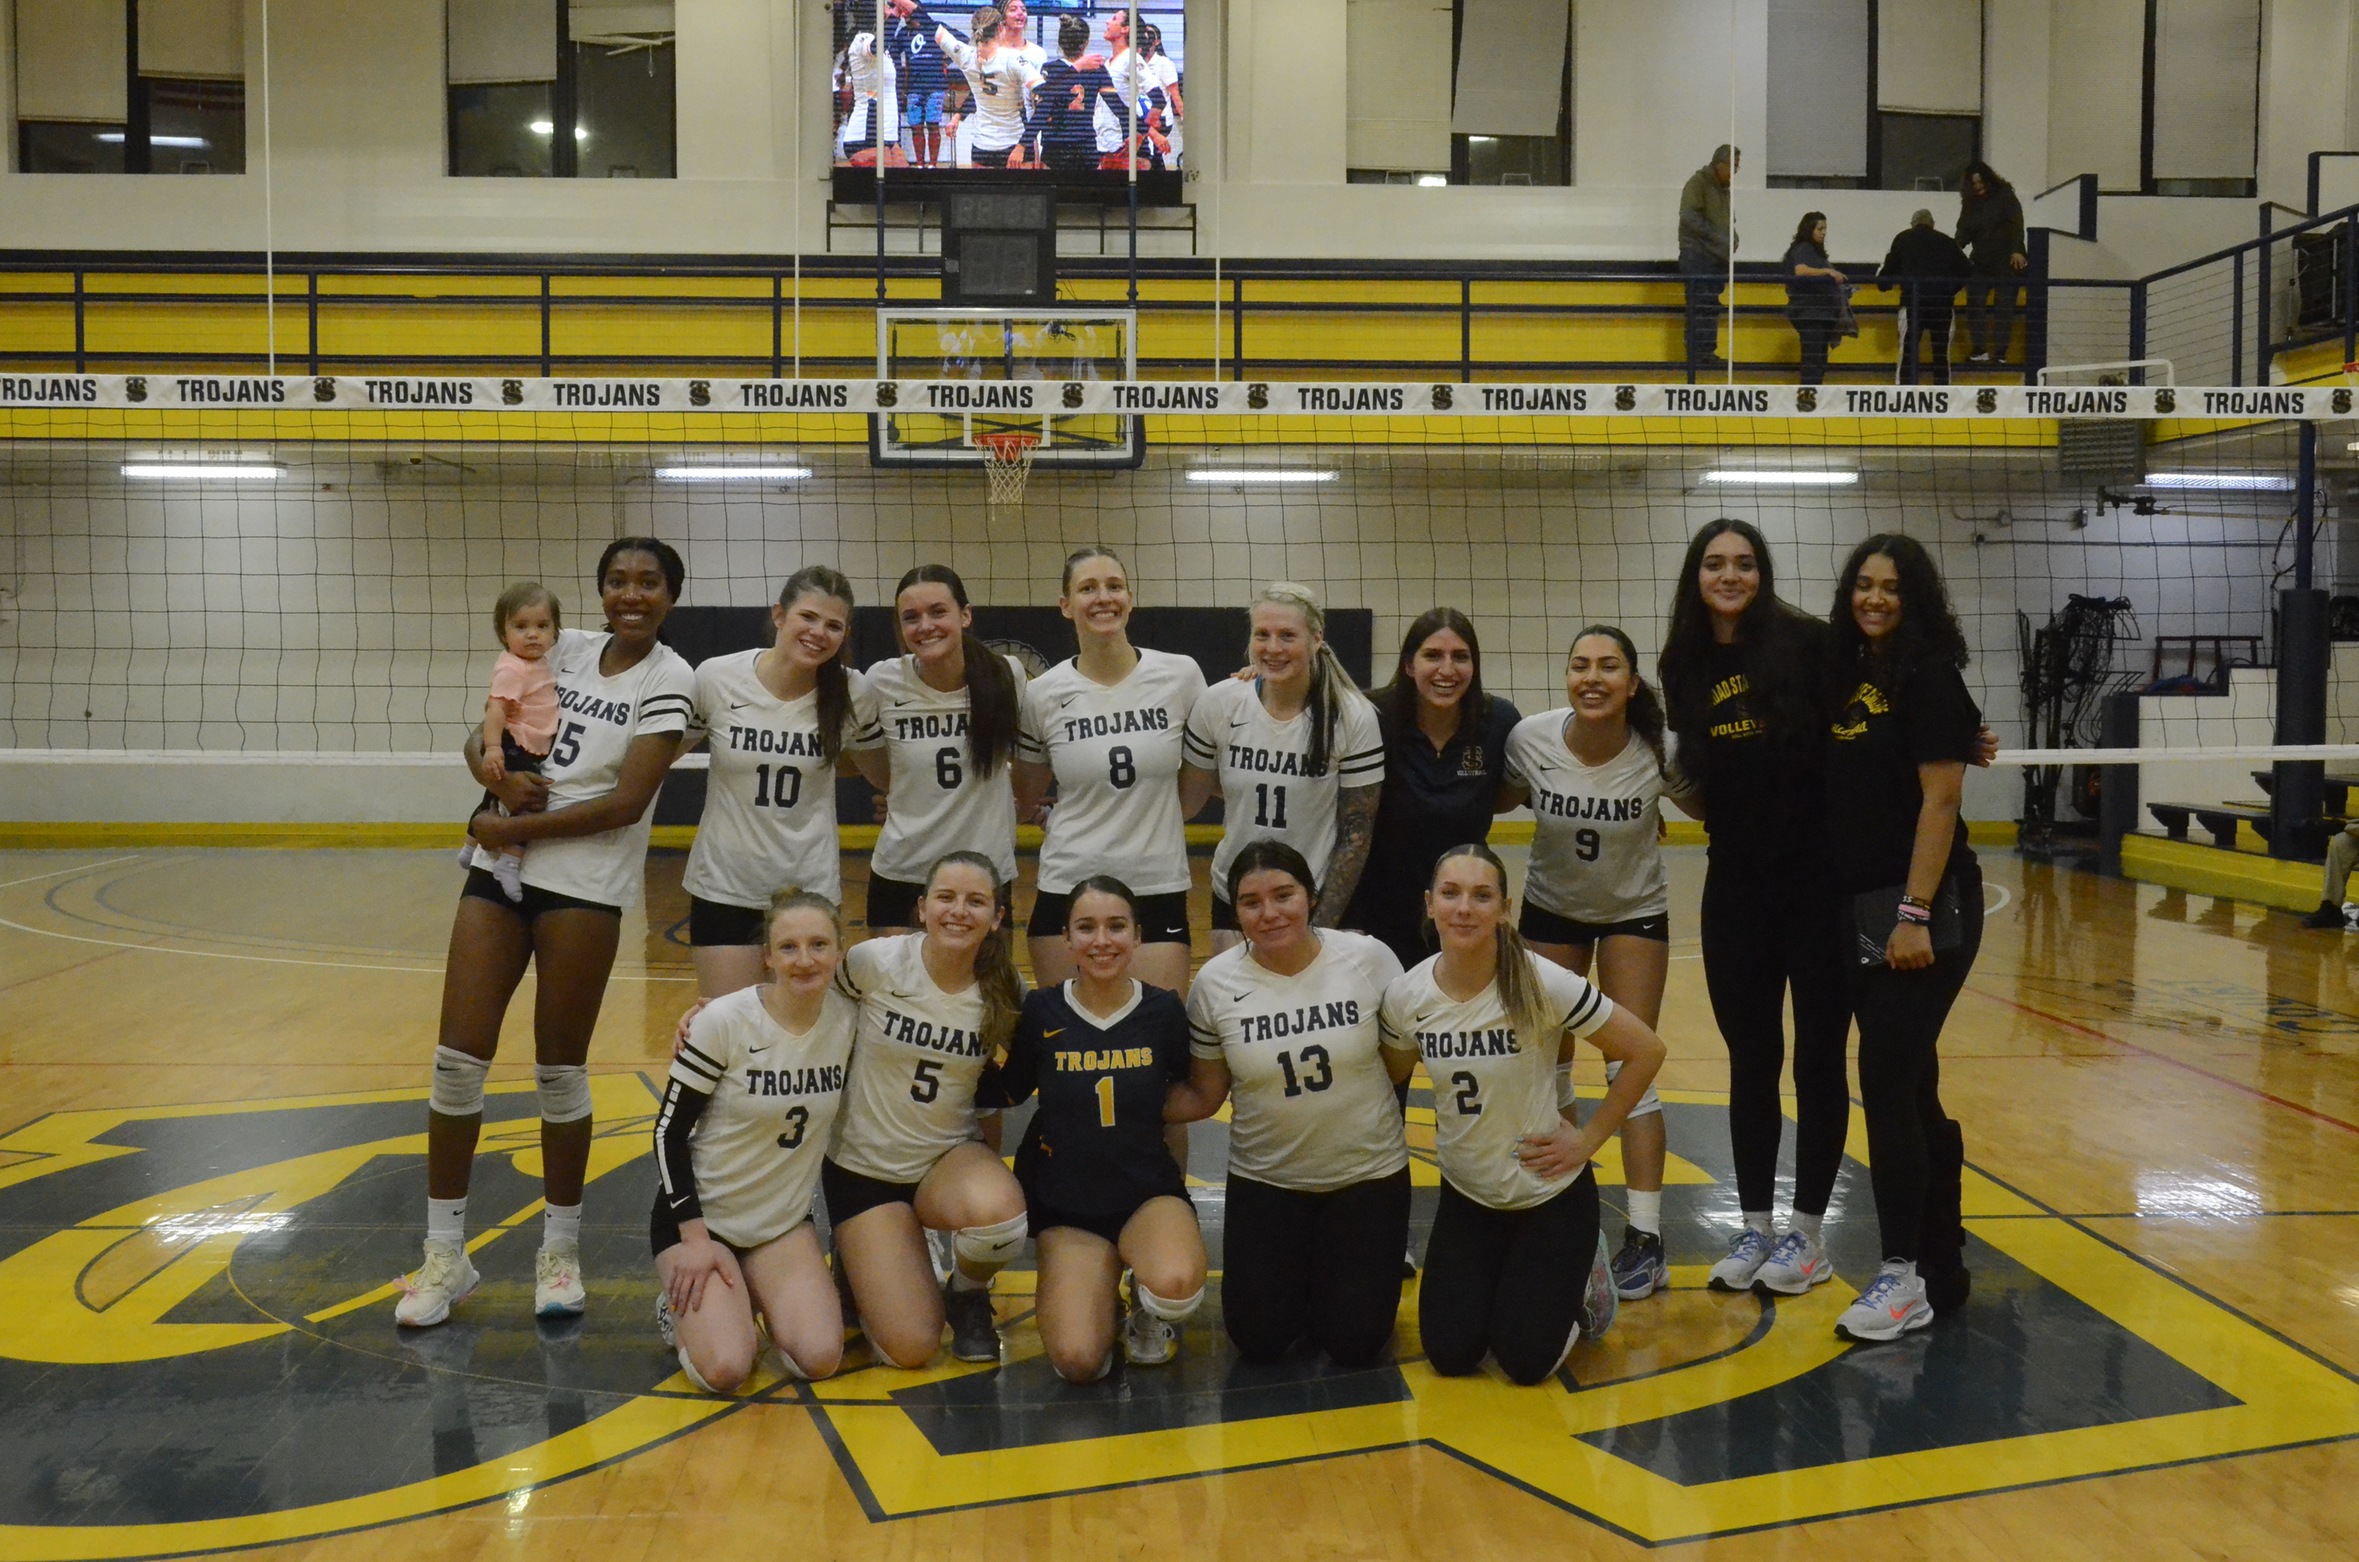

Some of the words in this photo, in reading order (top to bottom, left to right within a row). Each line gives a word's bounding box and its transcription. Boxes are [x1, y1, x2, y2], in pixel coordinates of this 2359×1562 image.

[980, 72, 999, 95] 5
[1068, 84, 1085, 110] 2
[0, 378, 96, 401] ROJANS
[177, 380, 284, 402] TROJANS
[366, 381, 472, 404] TROJANS
[554, 384, 659, 406] TROJANS
[741, 385, 847, 407] TROJANS
[928, 386, 1032, 408] TROJANS
[1113, 386, 1218, 408] TROJANS
[1298, 388, 1403, 410] TROJANS
[1482, 389, 1586, 410] TROJANS
[1665, 389, 1767, 411] TROJANS
[1846, 391, 1948, 413] TROJANS
[2026, 392, 2127, 413] TROJANS
[2204, 393, 2304, 414] TROJANS
[554, 685, 631, 726] ROJANS
[895, 713, 969, 740] TROJA
[1064, 707, 1169, 742] TROJANS
[553, 718, 587, 768] 5
[730, 725, 822, 757] TROJAN
[754, 763, 802, 809] 10
[936, 747, 962, 790] 6
[1108, 745, 1136, 790] 8
[1255, 783, 1286, 829] 11
[1539, 788, 1643, 822] TROJANS
[1575, 828, 1600, 862] 9
[883, 1011, 988, 1057] TROJAN
[1240, 1000, 1359, 1043] TROJANS
[746, 1065, 842, 1096] TROJANS
[1055, 1047, 1153, 1072] TROJANS
[1277, 1044, 1333, 1097] 13
[910, 1059, 944, 1104] 5
[1095, 1076, 1115, 1128] 1
[1451, 1071, 1482, 1116] 2
[777, 1105, 809, 1149] 3
